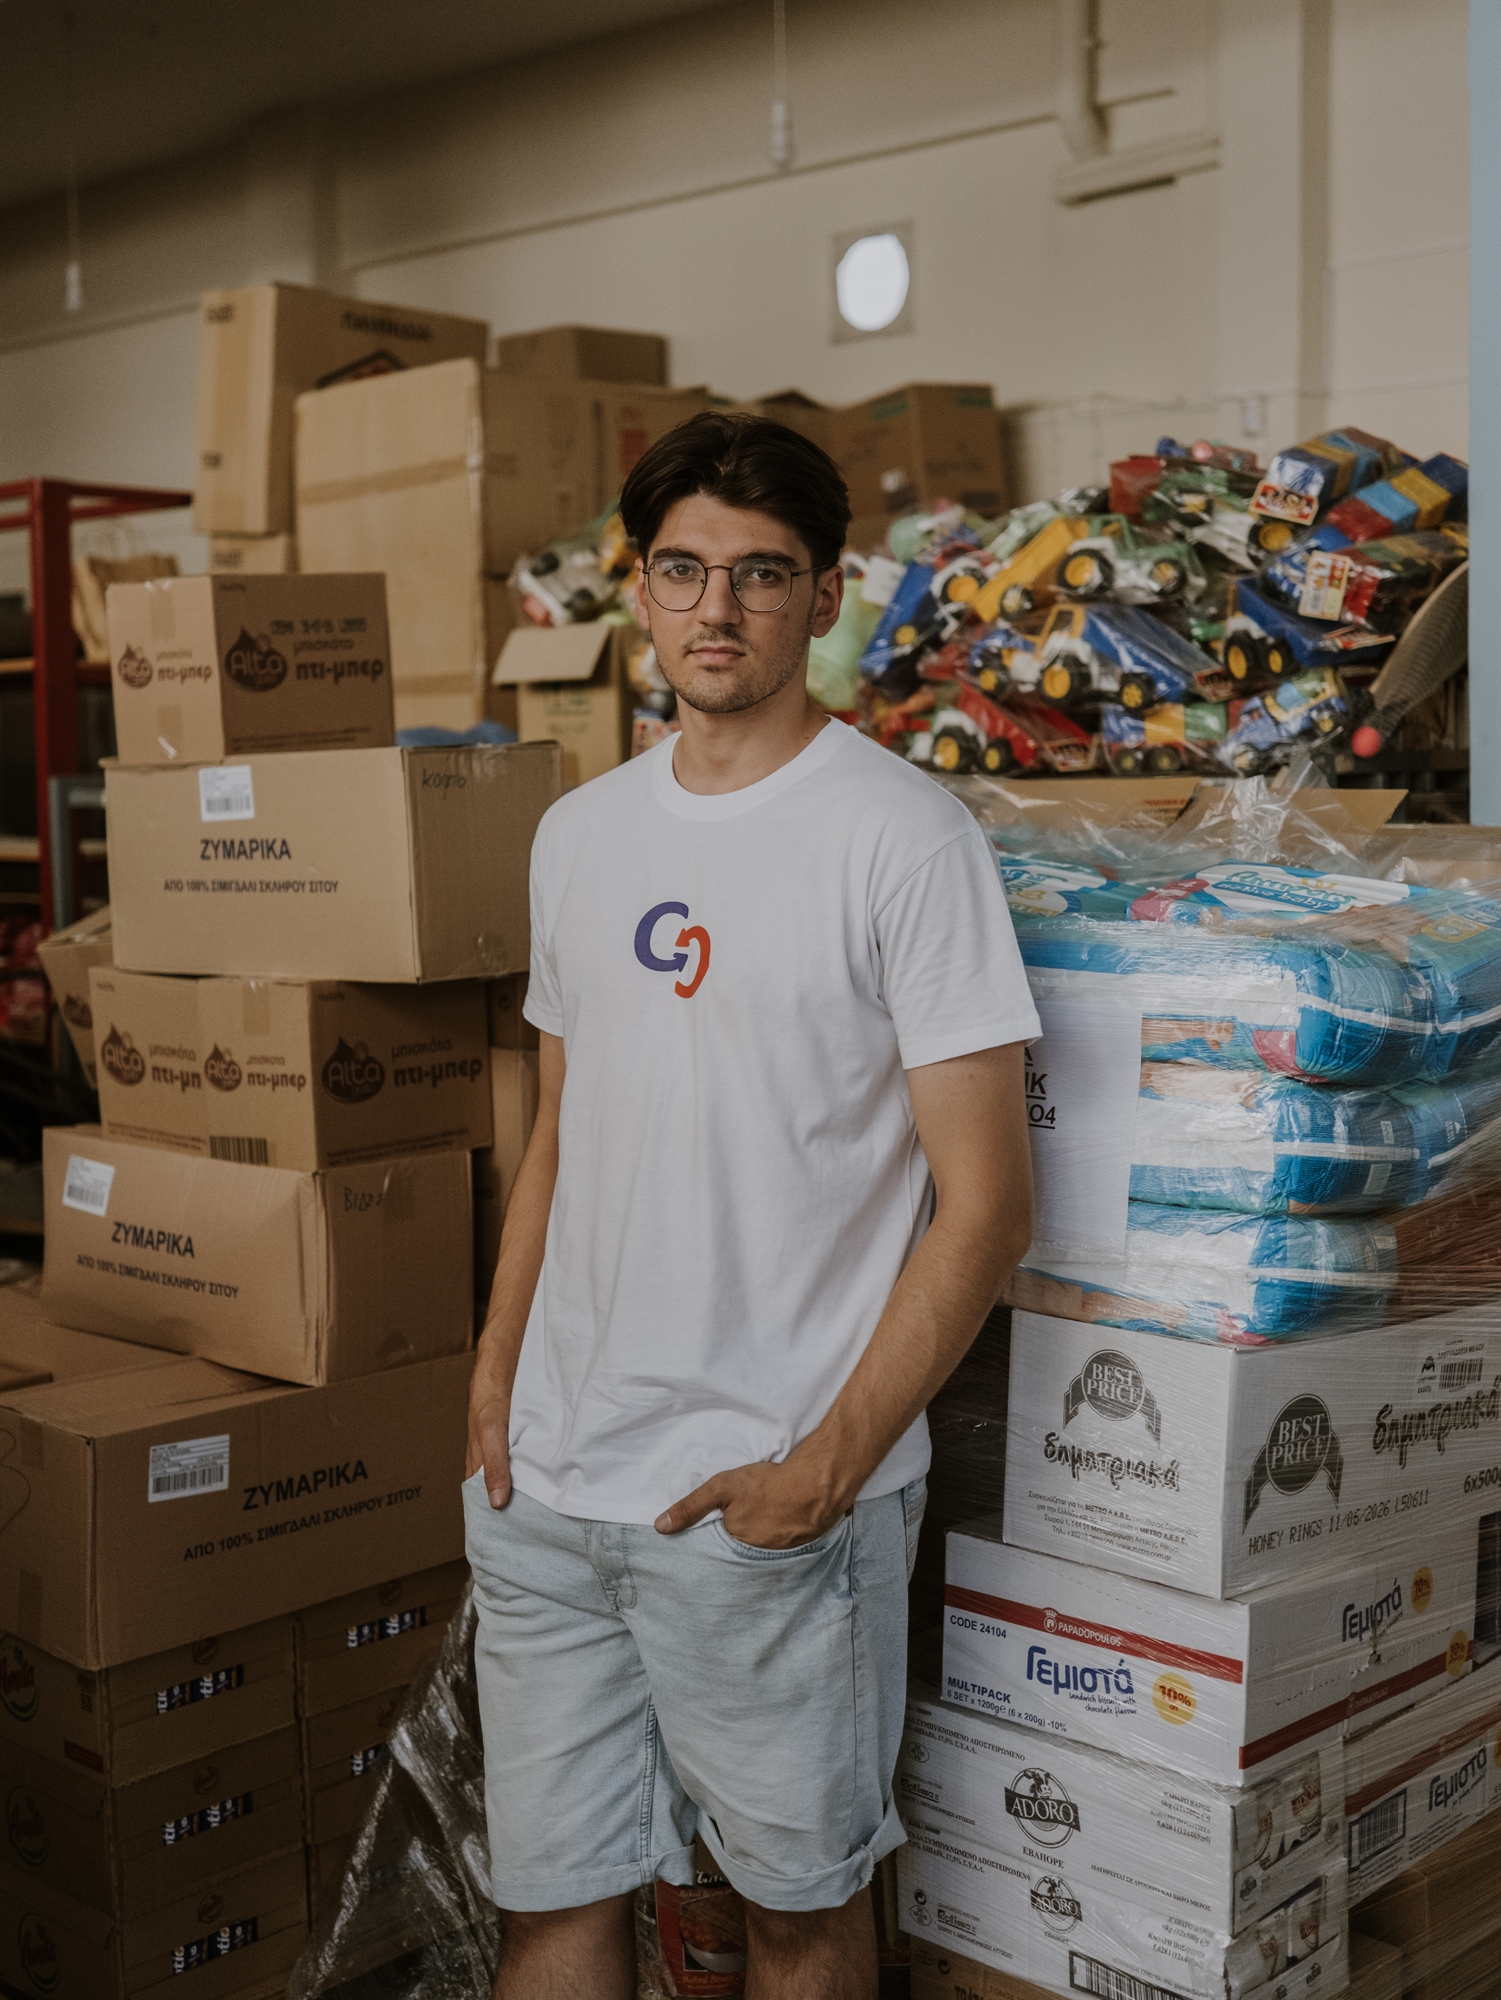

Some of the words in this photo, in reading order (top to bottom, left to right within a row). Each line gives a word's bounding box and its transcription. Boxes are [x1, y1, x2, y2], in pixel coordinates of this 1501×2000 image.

[296, 657, 385, 686] πτι-μπερ
[200, 838, 293, 861] ΖΥΜΑΡΙΚΑ
[163, 879, 184, 893] ΑΠΟ
[186, 879, 209, 893] 100%
[211, 879, 257, 893] ΣΙΜΙΓΔΑΛΙ
[259, 879, 306, 893] ΣΚΛΗΡΟΥ
[308, 879, 339, 893] ΣΙΤΟΥ
[1278, 892, 1329, 909] baby
[152, 1065, 201, 1093] πτι-μπ
[208, 1060, 240, 1080] Alta
[247, 1072, 307, 1093] πτι-μπερ
[328, 1062, 381, 1089] Alta
[394, 1057, 483, 1089] πτι-μπερ
[112, 1221, 196, 1258] ΖΥΜΑΡΙΚΑ
[77, 1254, 95, 1269] ΑΠΟ
[119, 1262, 161, 1285] ΣΙΜΙΓΔΑΛΙ
[162, 1273, 206, 1293] ΣΚΛΗΡΟΥ
[209, 1282, 240, 1299] ΣΙΤΟΥ
[1091, 1362, 1139, 1385] BEST
[1086, 1378, 1141, 1404] PRICE
[1278, 1413, 1325, 1445] BEST
[1270, 1435, 1328, 1470] PRICE
[242, 1459, 369, 1511] ΖΥΜΑΡΙΚΑ
[1463, 1466, 1501, 1493] 6x500
[183, 1541, 215, 1561] ΑΠΟ
[219, 1532, 254, 1552] 100%
[256, 1513, 321, 1542] ΣΙΜΙΓΔΑΛΙ
[323, 1496, 384, 1523] ΣΚΛΗΡΟΥ
[386, 1485, 424, 1507] ΣΙΤΟΥ
[1249, 1529, 1285, 1556] HONEY
[1289, 1519, 1324, 1545] RINGS
[1342, 1577, 1403, 1643] Γεμιστά
[950, 1614, 978, 1631] CODE
[979, 1622, 1008, 1639] 24104
[1058, 1621, 1123, 1647] PAPADOPOULOS
[1026, 1645, 1135, 1695] Γεμιστά
[947, 1676, 1012, 1704] MULTIPACK
[953, 1692, 970, 1703] SET
[1024, 1713, 1046, 1728] 200g)
[1085, 1703, 1113, 1715] chocolate
[1114, 1706, 1138, 1718] flavour
[1012, 1797, 1075, 1824] ADORO
[1022, 1846, 1064, 1869] ΕΒΑΠΟΡΕ
